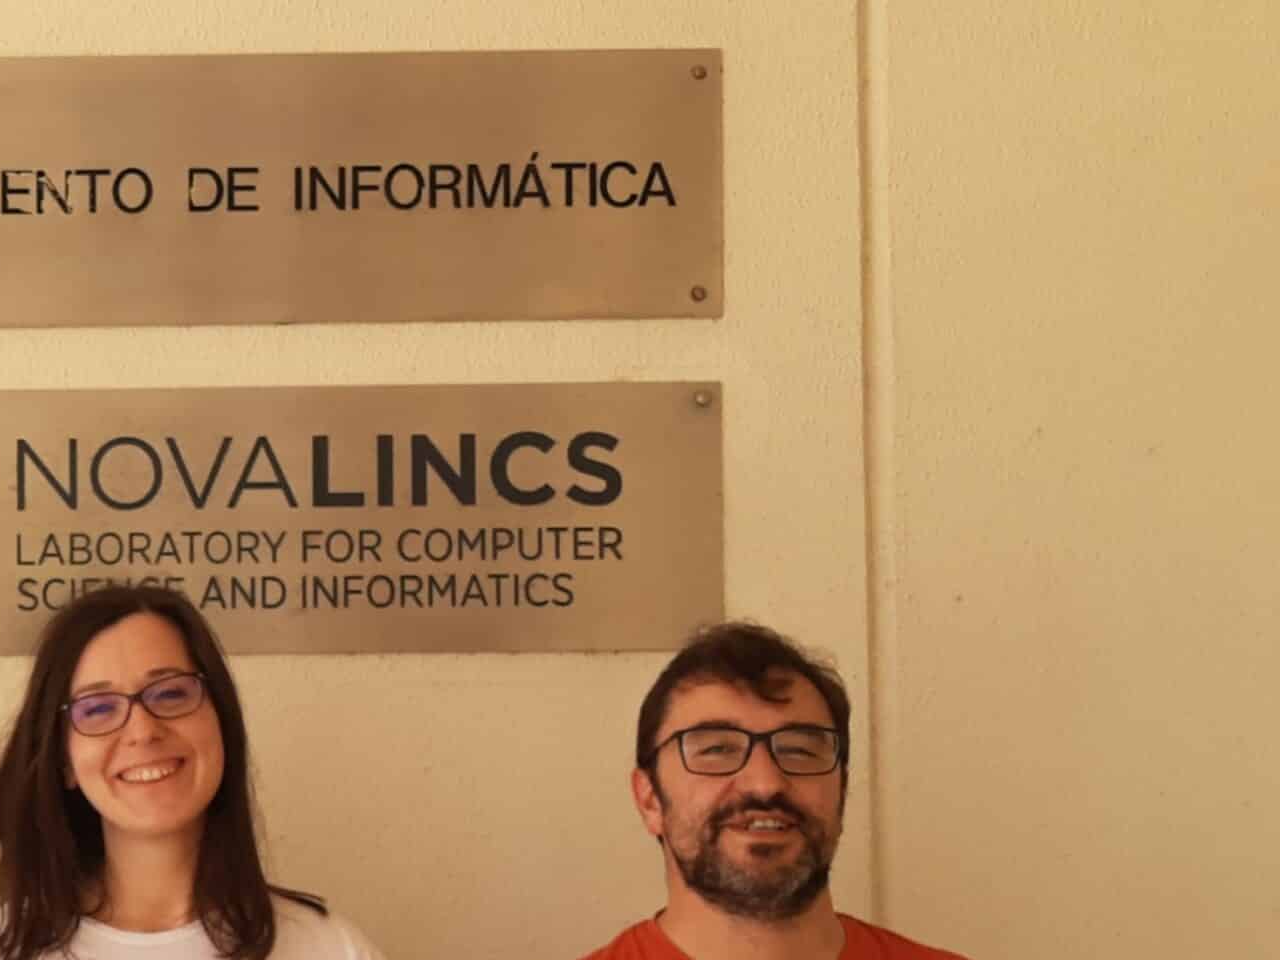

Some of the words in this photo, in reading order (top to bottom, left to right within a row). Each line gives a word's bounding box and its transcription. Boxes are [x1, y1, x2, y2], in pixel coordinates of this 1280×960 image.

[187, 165, 261, 212] DE
[293, 151, 677, 211] INFORMÁTICA
[16, 530, 287, 566] LABORATORY
[301, 529, 382, 563] FOR
[397, 526, 624, 562] COMPUTER
[199, 575, 288, 610] AND
[301, 572, 575, 609] INFORMATICS
